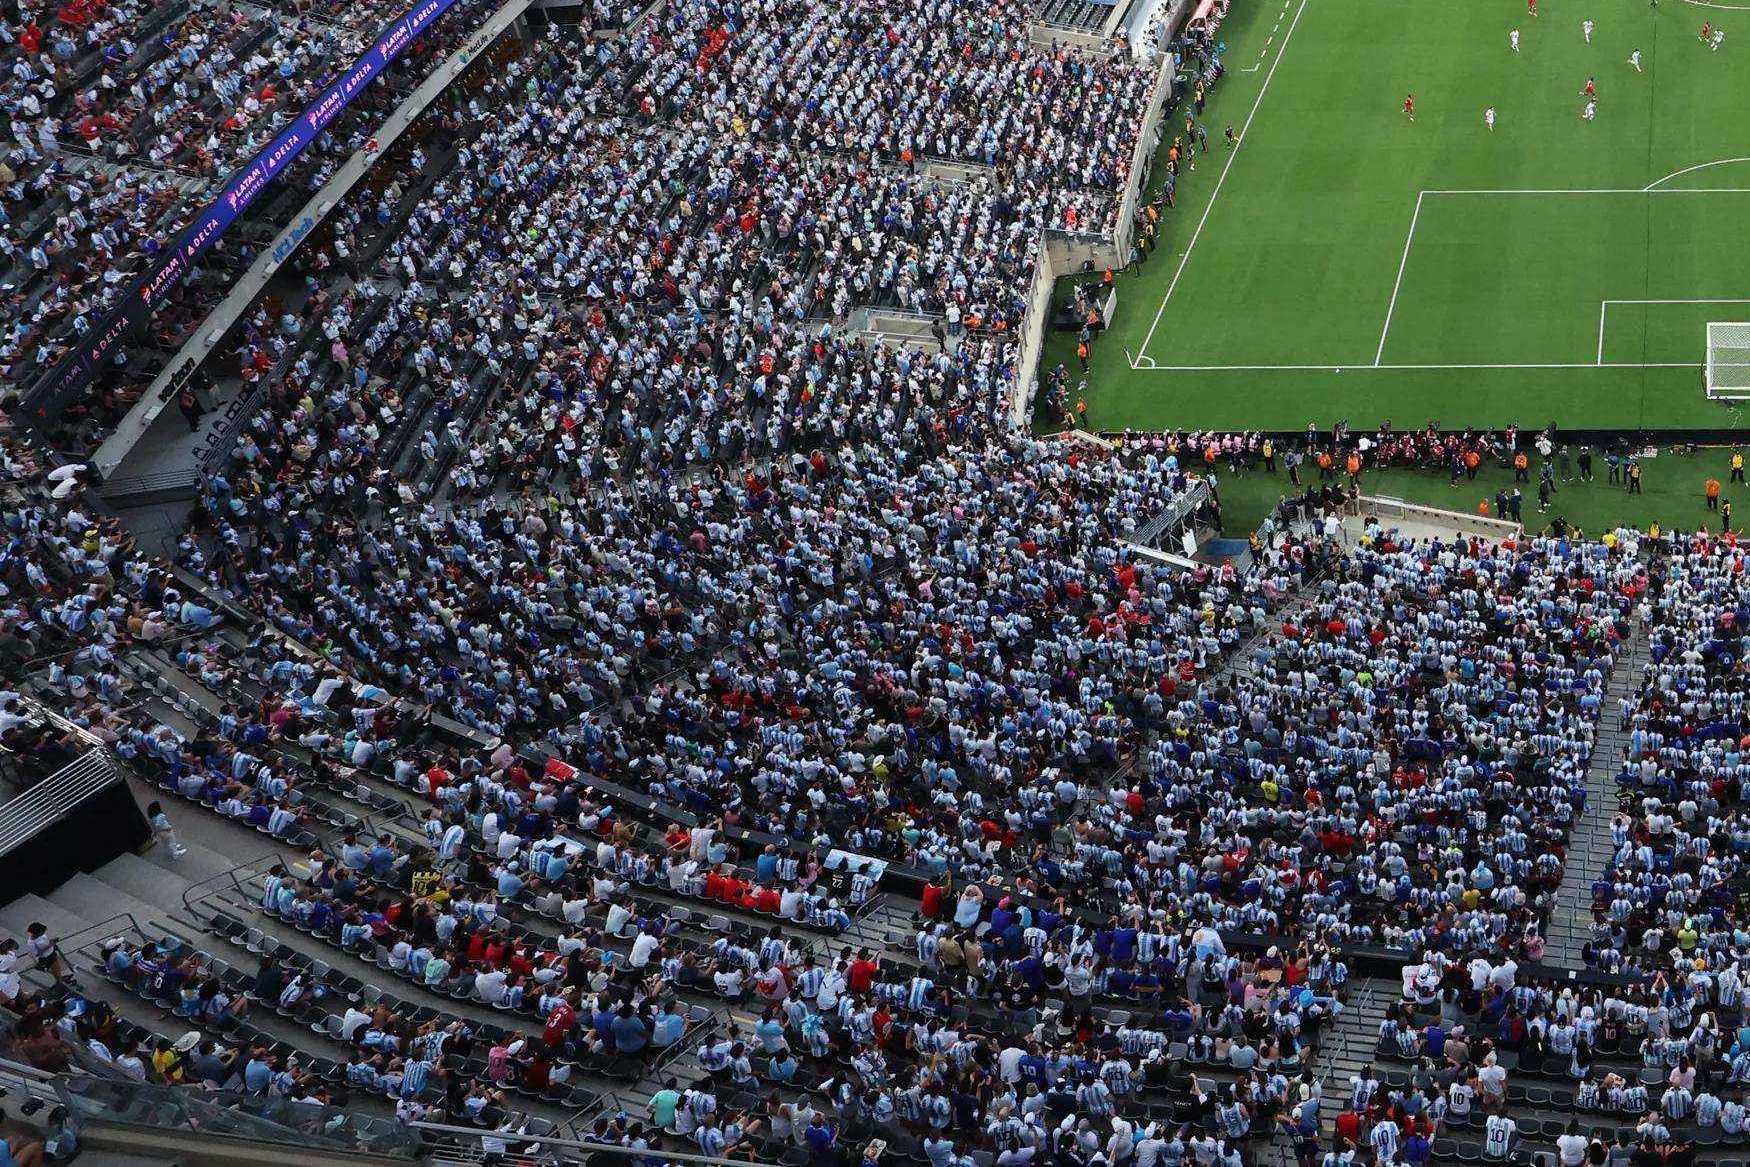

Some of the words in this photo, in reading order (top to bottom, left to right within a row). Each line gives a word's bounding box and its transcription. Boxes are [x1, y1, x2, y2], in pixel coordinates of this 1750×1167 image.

[385, 26, 407, 48] LATAM
[418, 2, 439, 22] DELTA
[467, 35, 489, 56] MetLife
[315, 92, 340, 118] LATAM
[354, 63, 372, 86] DELTA
[234, 168, 262, 198] LATAM
[274, 135, 299, 161] DELTA
[150, 258, 180, 291] LATAM
[193, 219, 219, 250] DELTA
[99, 316, 130, 349] DELTA
[832, 876, 843, 887] 22
[1605, 1028, 1616, 1040] 10
[1357, 1090, 1367, 1103] 10
[1454, 1093, 1464, 1105] 10
[1379, 1130, 1389, 1146] 10
[1490, 1130, 1504, 1144] 10
